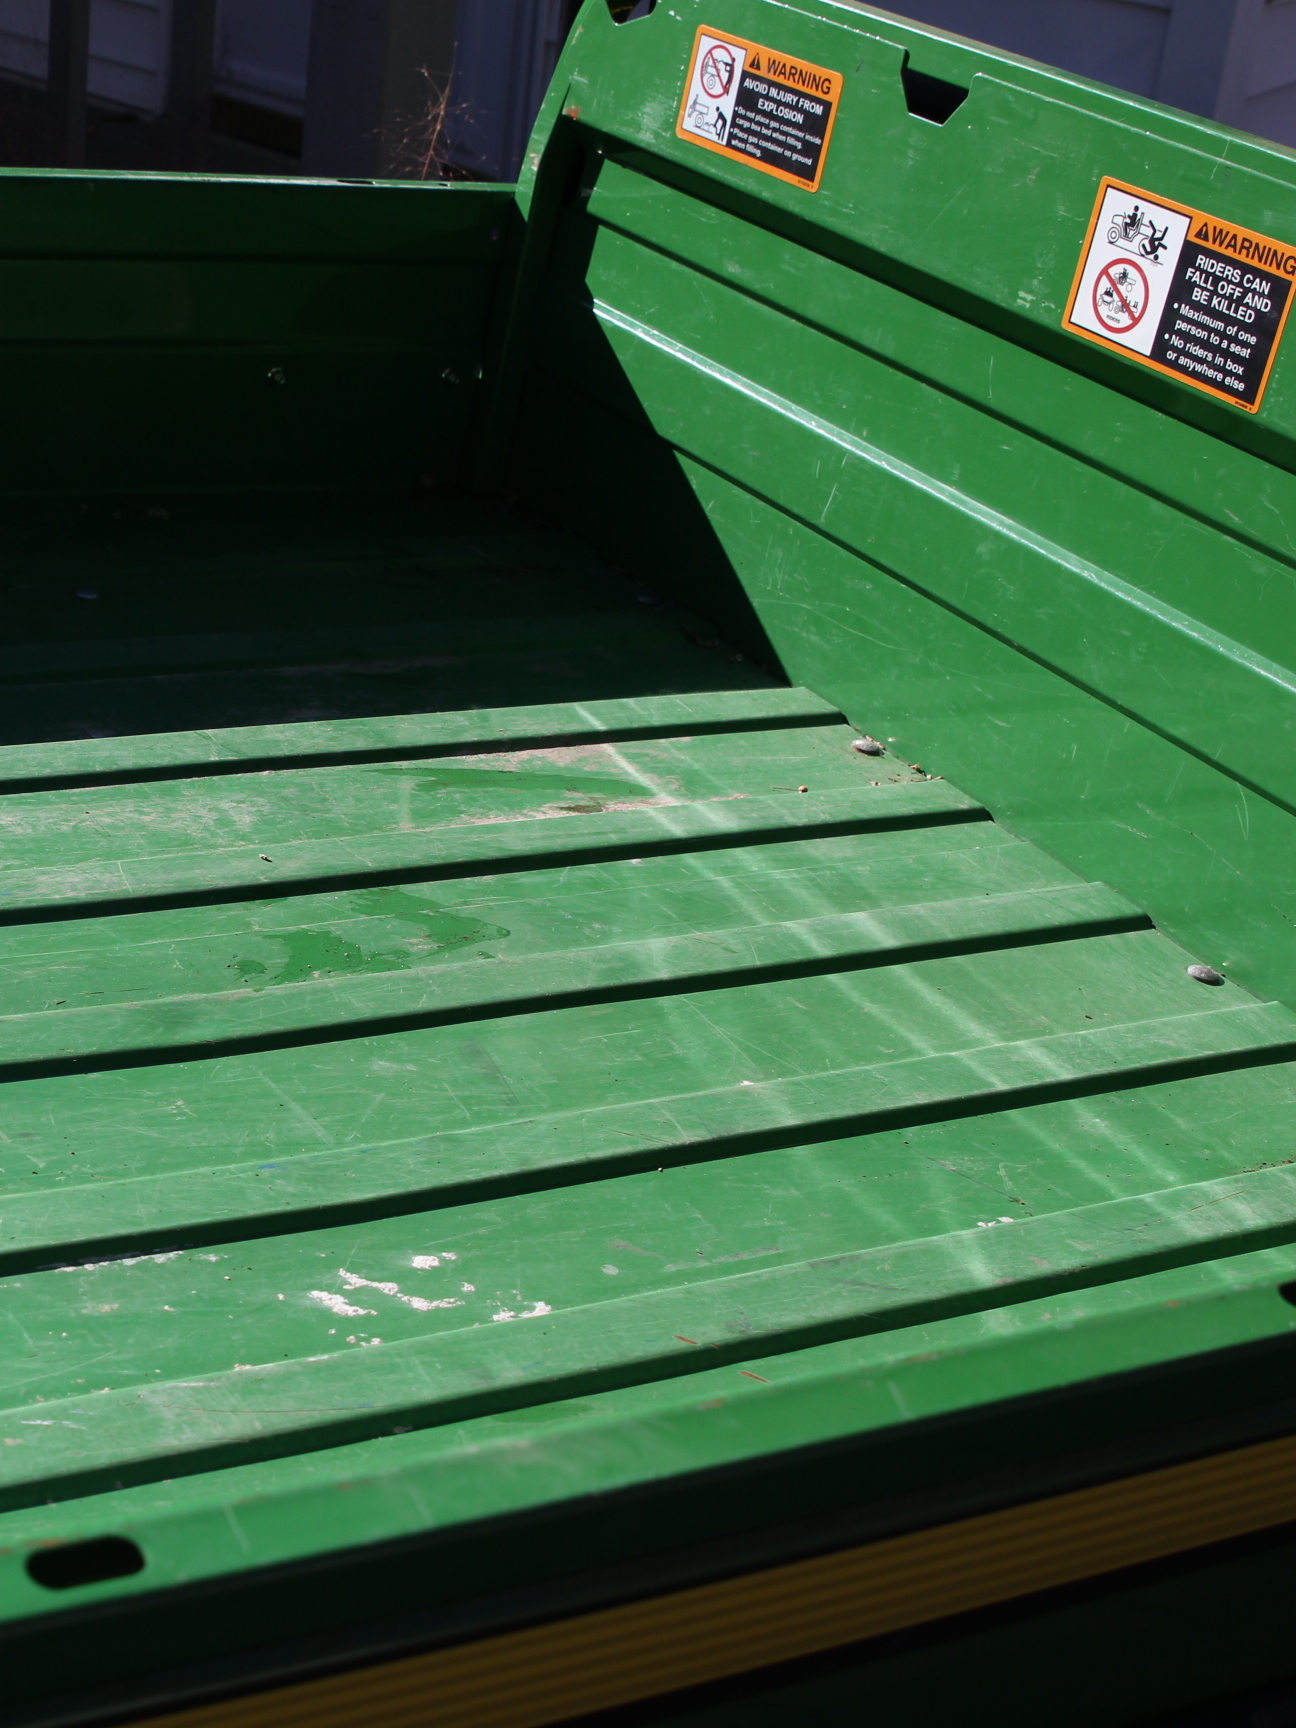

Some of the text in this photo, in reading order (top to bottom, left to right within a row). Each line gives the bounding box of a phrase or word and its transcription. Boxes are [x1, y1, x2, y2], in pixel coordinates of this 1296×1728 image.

[766, 57, 832, 95] WARNING
[743, 78, 823, 116] AVOID INJURY FROM
[758, 99, 803, 124] EXPLOSION
[736, 118, 803, 149] cargo box bed when filling.
[738, 107, 821, 145] Do not place gas container inside
[731, 140, 762, 158] when filling.
[733, 128, 812, 165] Place gas container on ground
[1212, 226, 1296, 276] WARNING
[1186, 268, 1271, 313] FALL OFF AND
[1196, 255, 1271, 295] RIDERS CAN
[1180, 304, 1257, 345] Maximum of one
[1192, 289, 1255, 323] BE KILLED
[1170, 336, 1244, 375] No riders in box
[1175, 320, 1251, 359] person to a seat
[1166, 351, 1245, 392] or anywhere else
